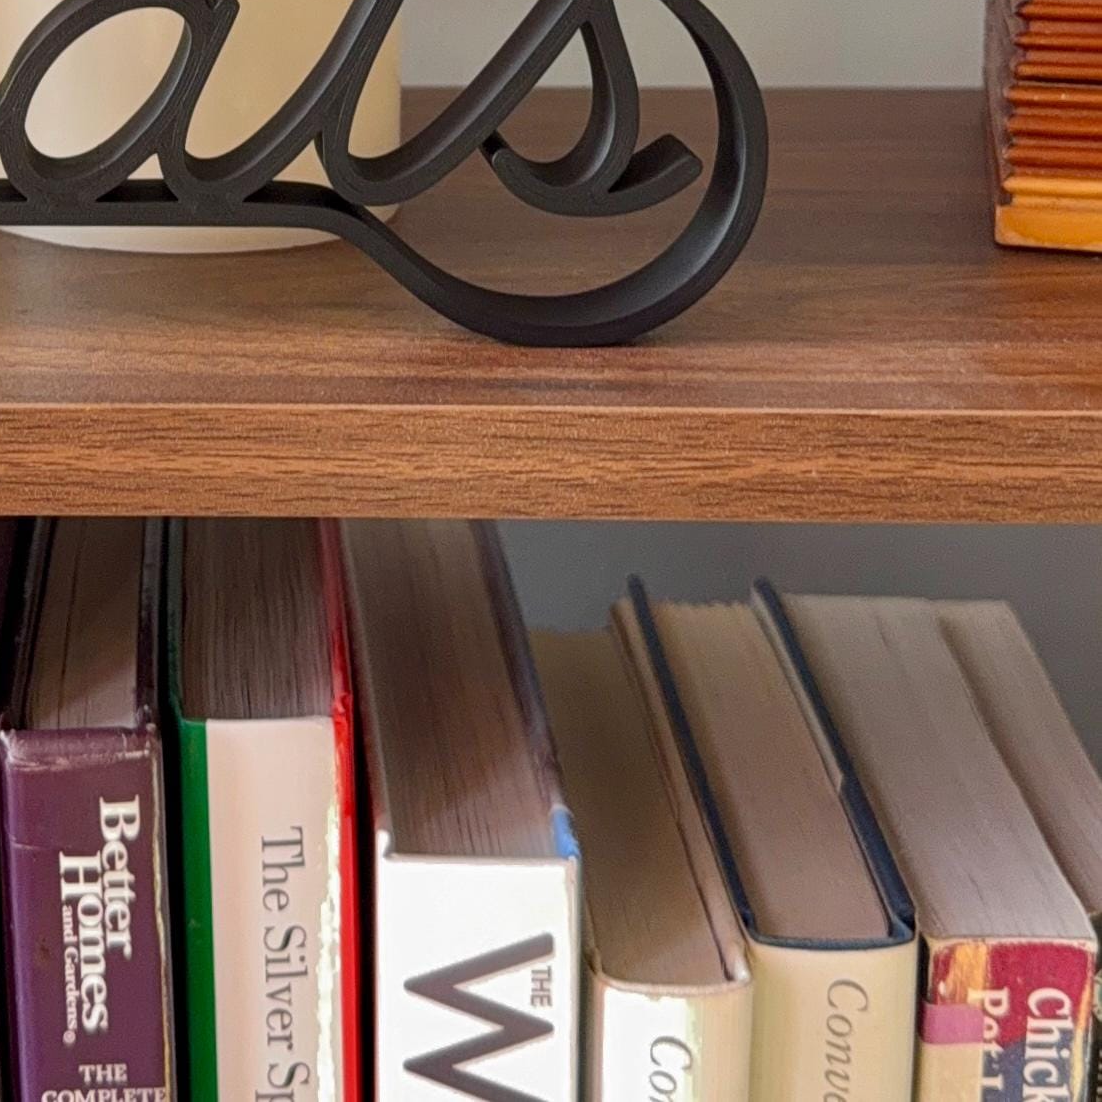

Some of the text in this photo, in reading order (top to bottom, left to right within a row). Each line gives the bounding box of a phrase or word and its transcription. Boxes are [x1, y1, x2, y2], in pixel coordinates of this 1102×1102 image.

[99, 794, 140, 960] Better
[261, 826, 306, 912] The
[59, 851, 109, 1033] Homes
[62, 905, 78, 945] and
[263, 925, 309, 1051] Silver
[530, 965, 553, 1007] THE
[78, 1063, 128, 1084] THE
